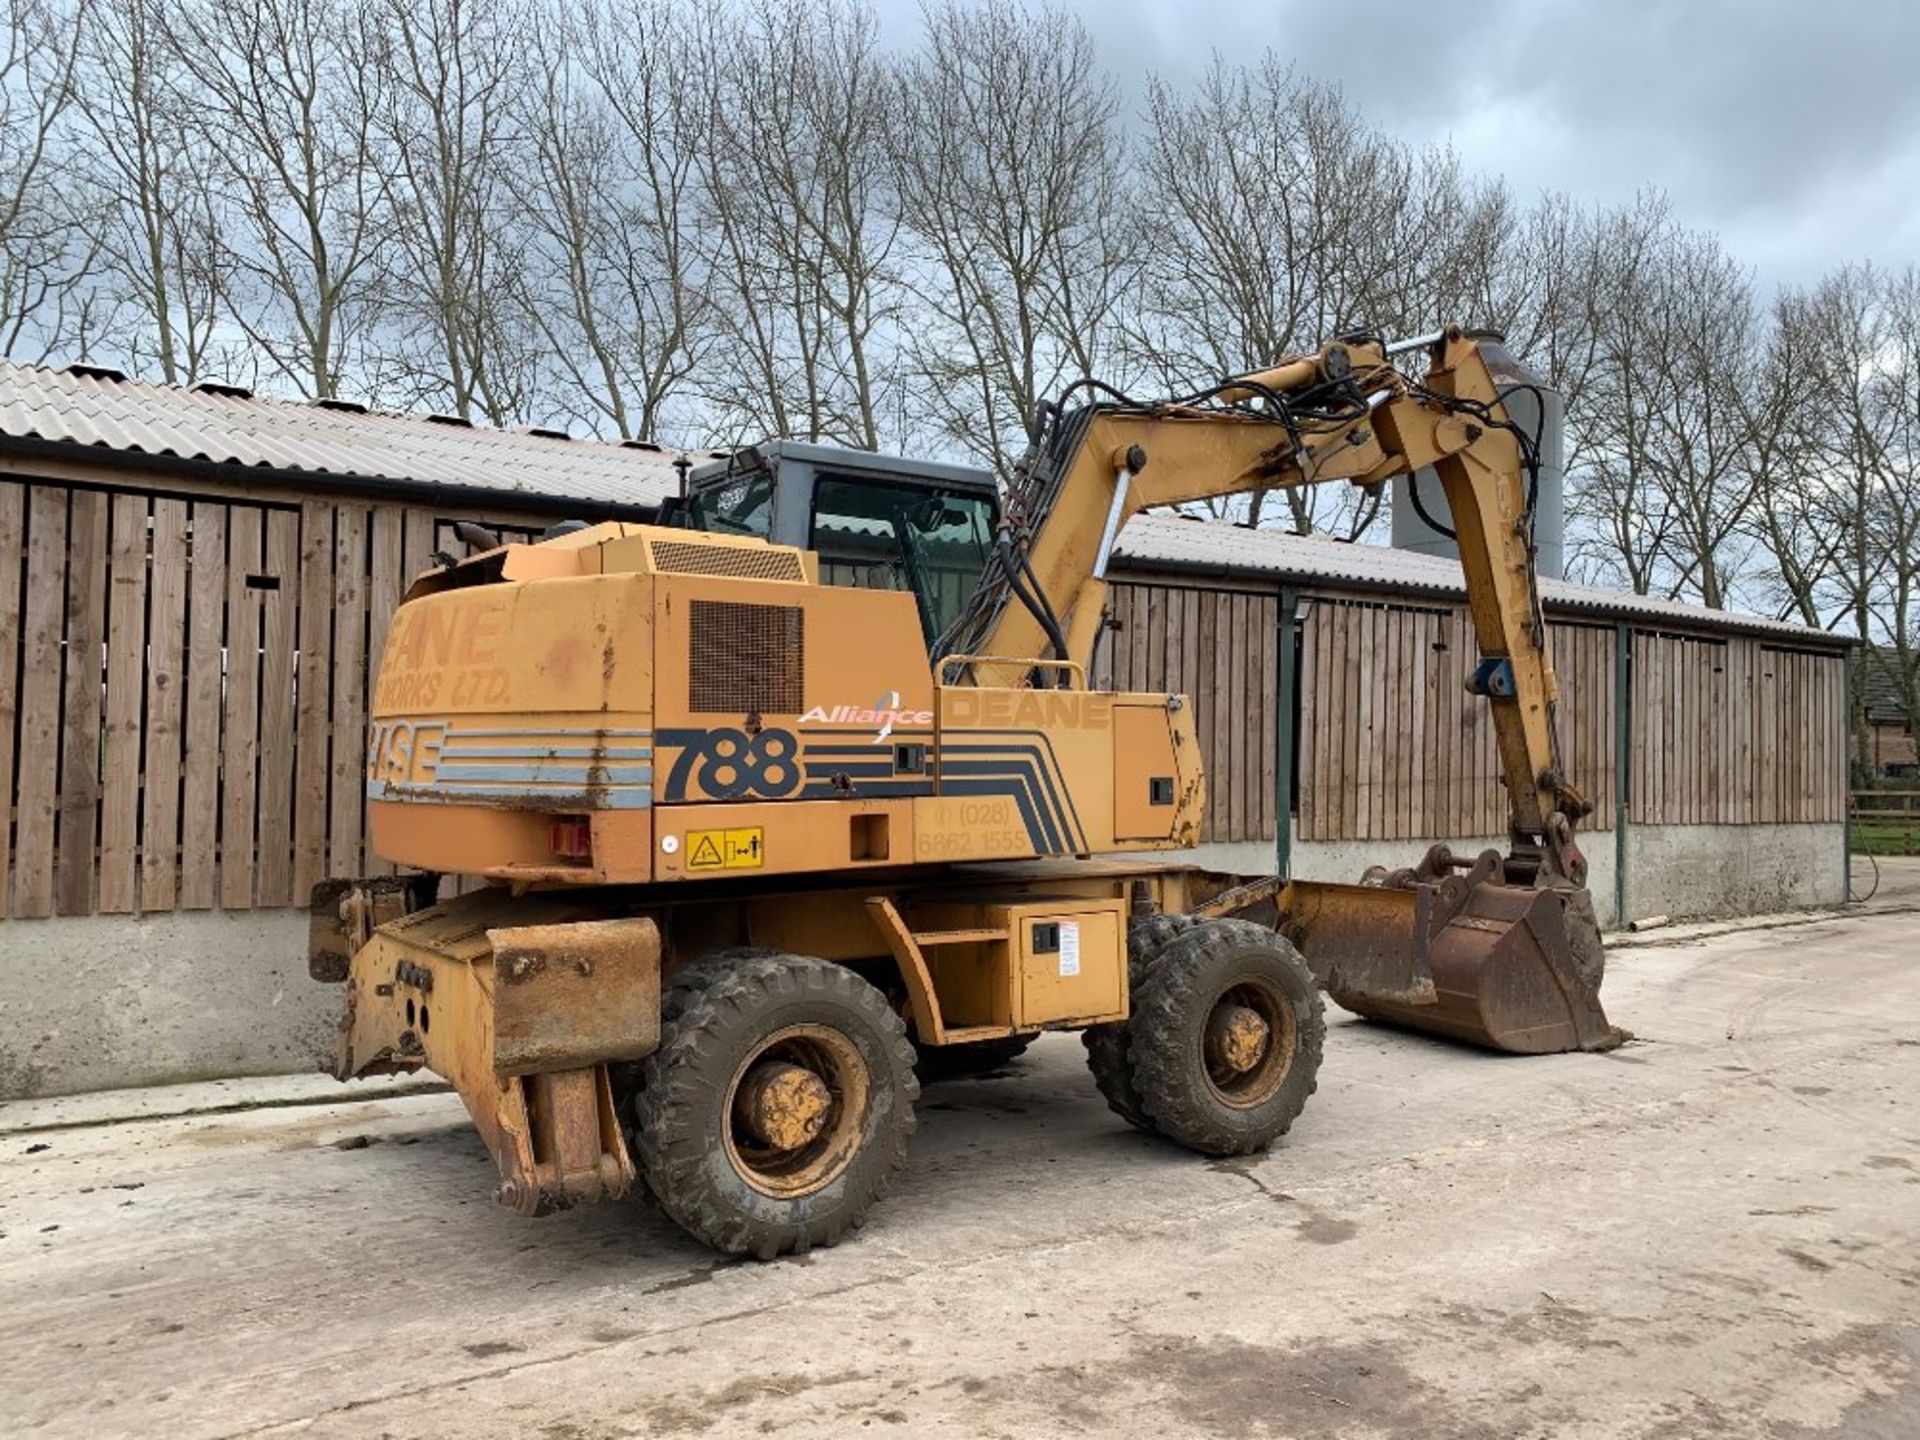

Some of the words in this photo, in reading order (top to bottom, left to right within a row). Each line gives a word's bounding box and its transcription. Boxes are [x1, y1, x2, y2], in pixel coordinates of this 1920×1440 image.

[452, 668, 512, 705] LTD.
[797, 705, 934, 725] Alliance
[942, 694, 1110, 729] DEANE
[655, 727, 800, 801] 788
[960, 801, 1009, 827] (028)
